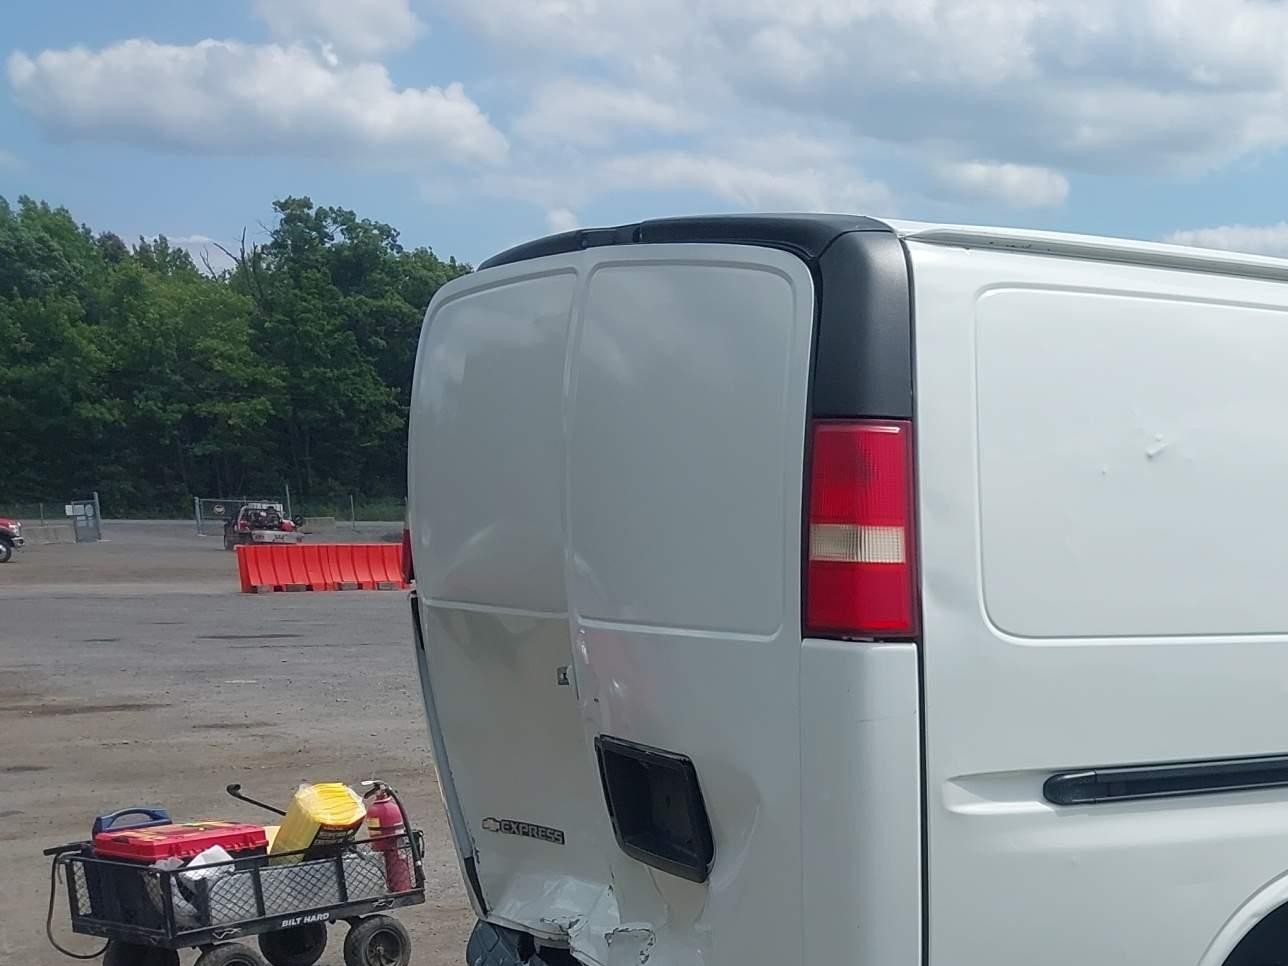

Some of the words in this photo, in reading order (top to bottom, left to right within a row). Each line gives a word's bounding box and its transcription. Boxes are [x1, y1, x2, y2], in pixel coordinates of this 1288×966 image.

[500, 819, 564, 844] EXPRESS
[281, 917, 302, 928] BILT
[303, 912, 330, 924] HARD
